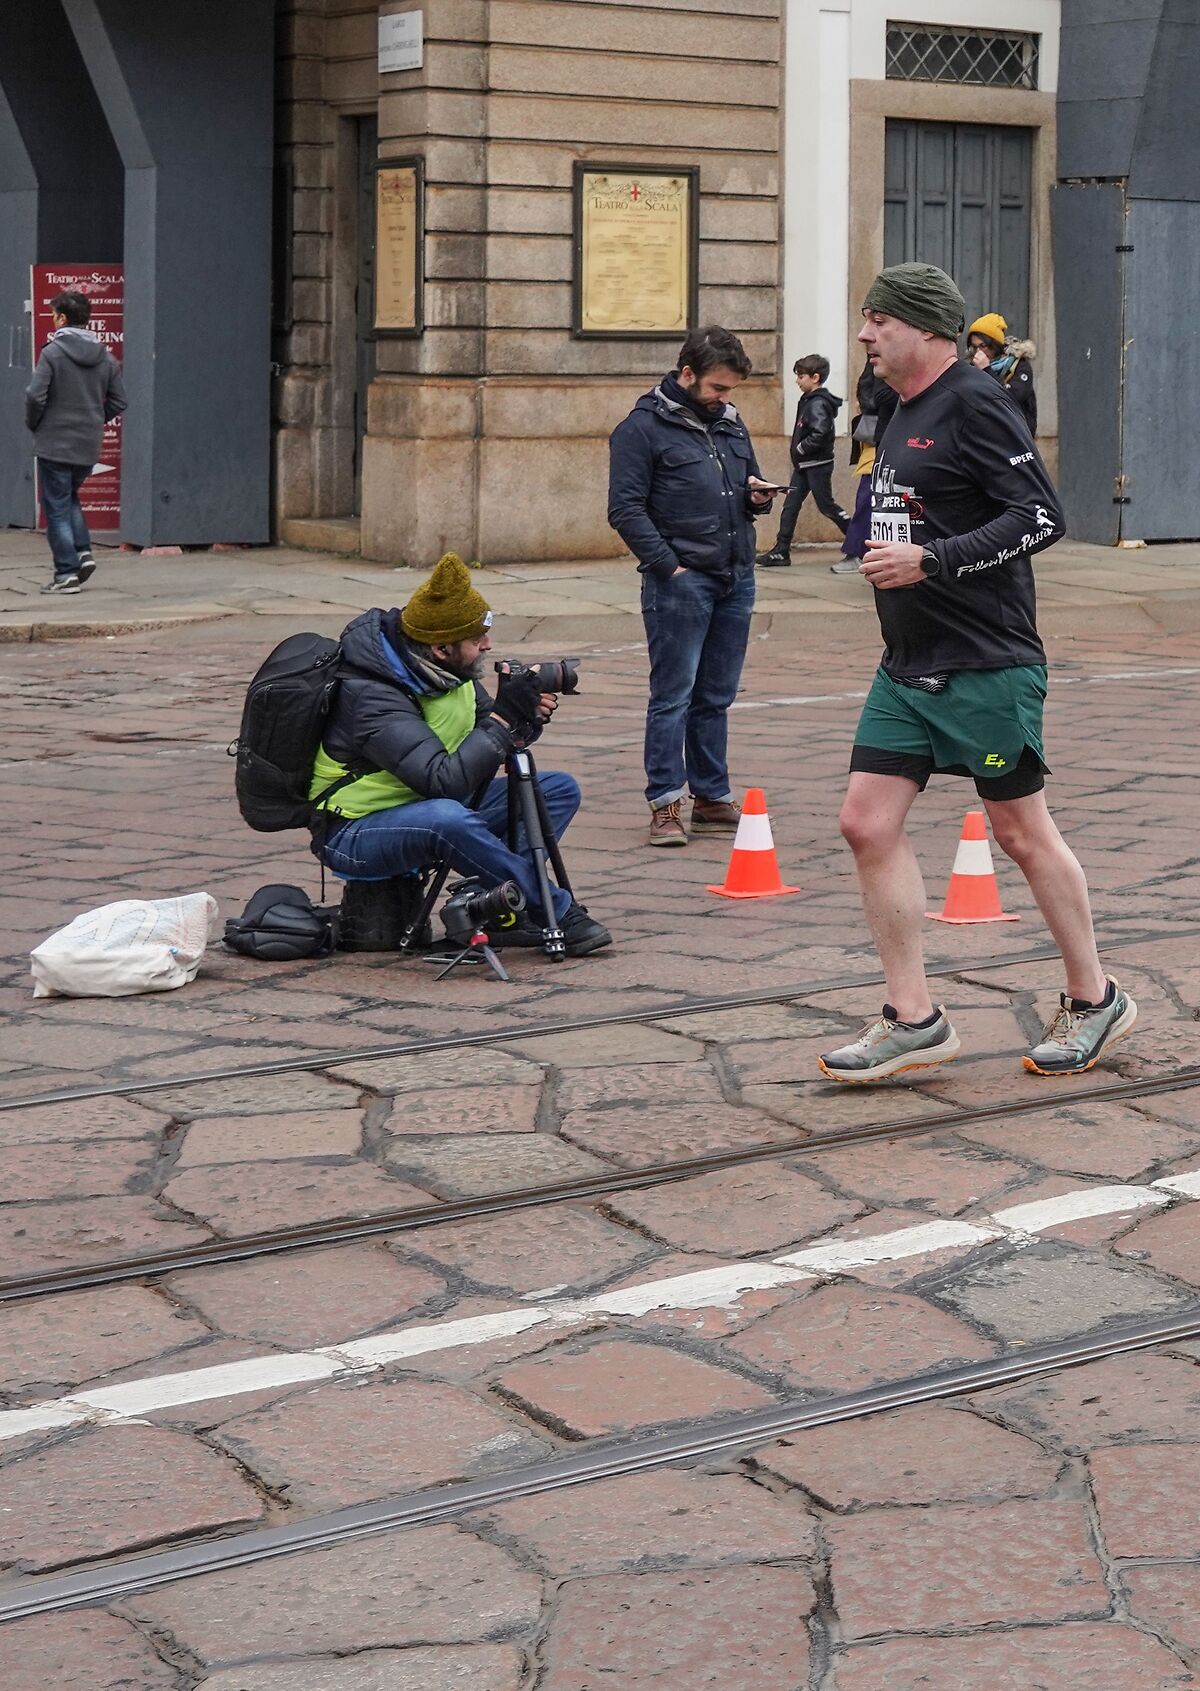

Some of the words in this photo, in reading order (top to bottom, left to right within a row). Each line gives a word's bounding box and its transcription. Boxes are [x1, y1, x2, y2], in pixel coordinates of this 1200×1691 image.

[591, 196, 629, 210] TEATRO
[644, 199, 679, 212] SCALA
[46, 272, 77, 284] TEATRO
[91, 272, 124, 284] SCALA
[1009, 451, 1035, 466] BPER
